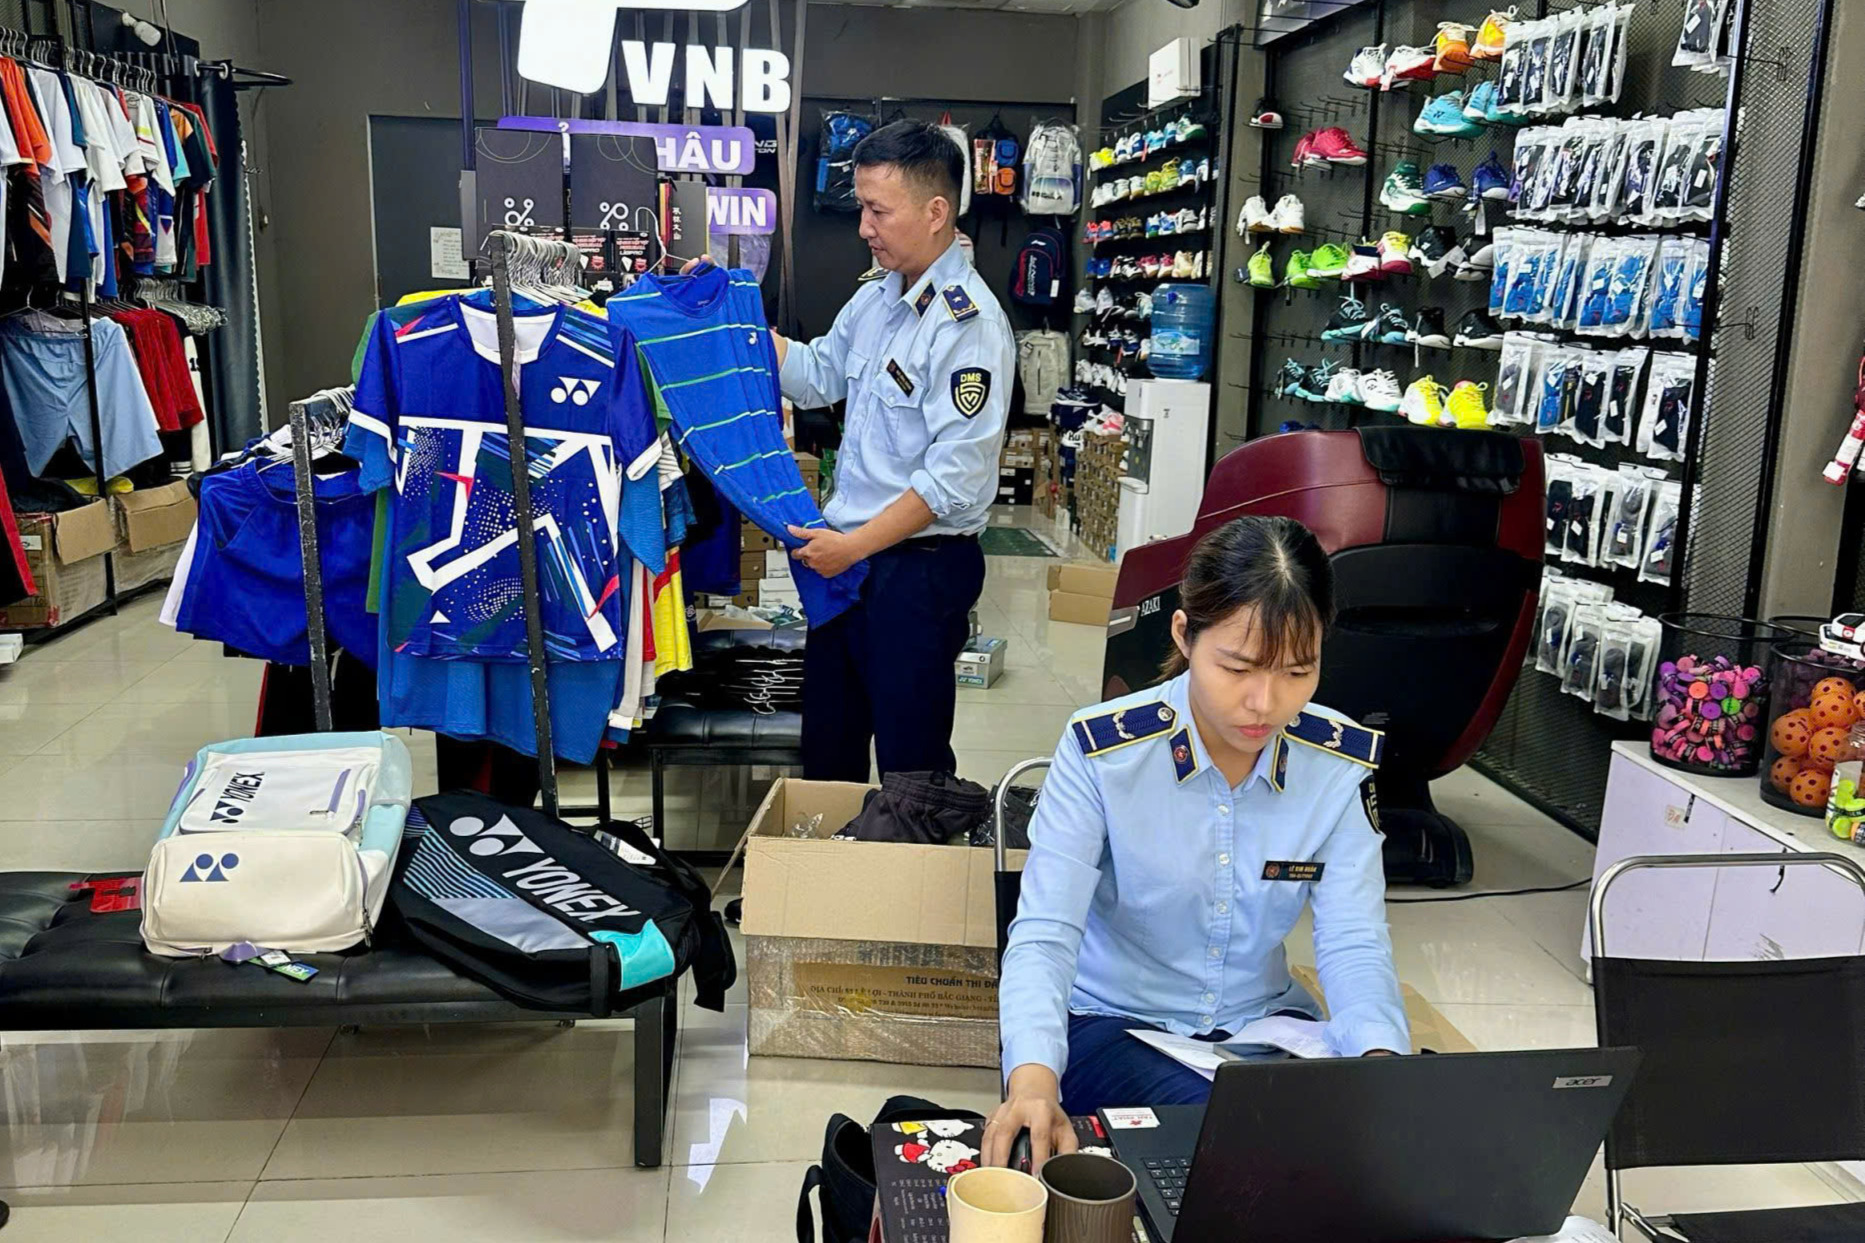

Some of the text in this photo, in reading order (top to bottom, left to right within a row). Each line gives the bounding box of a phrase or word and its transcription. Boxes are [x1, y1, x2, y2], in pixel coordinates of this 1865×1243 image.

[621, 40, 791, 113] VNB
[960, 373, 982, 383] DMS
[1140, 595, 1161, 617] AZAKI
[220, 772, 265, 803] YONEX
[502, 857, 642, 924] YONEX
[905, 975, 928, 986] TIÊU
[965, 979, 982, 988] THI
[888, 989, 917, 999] THÀNH
[918, 990, 936, 1000] PHỐ
[954, 994, 982, 1003] GIANG
[1566, 1078, 1602, 1087] acer
